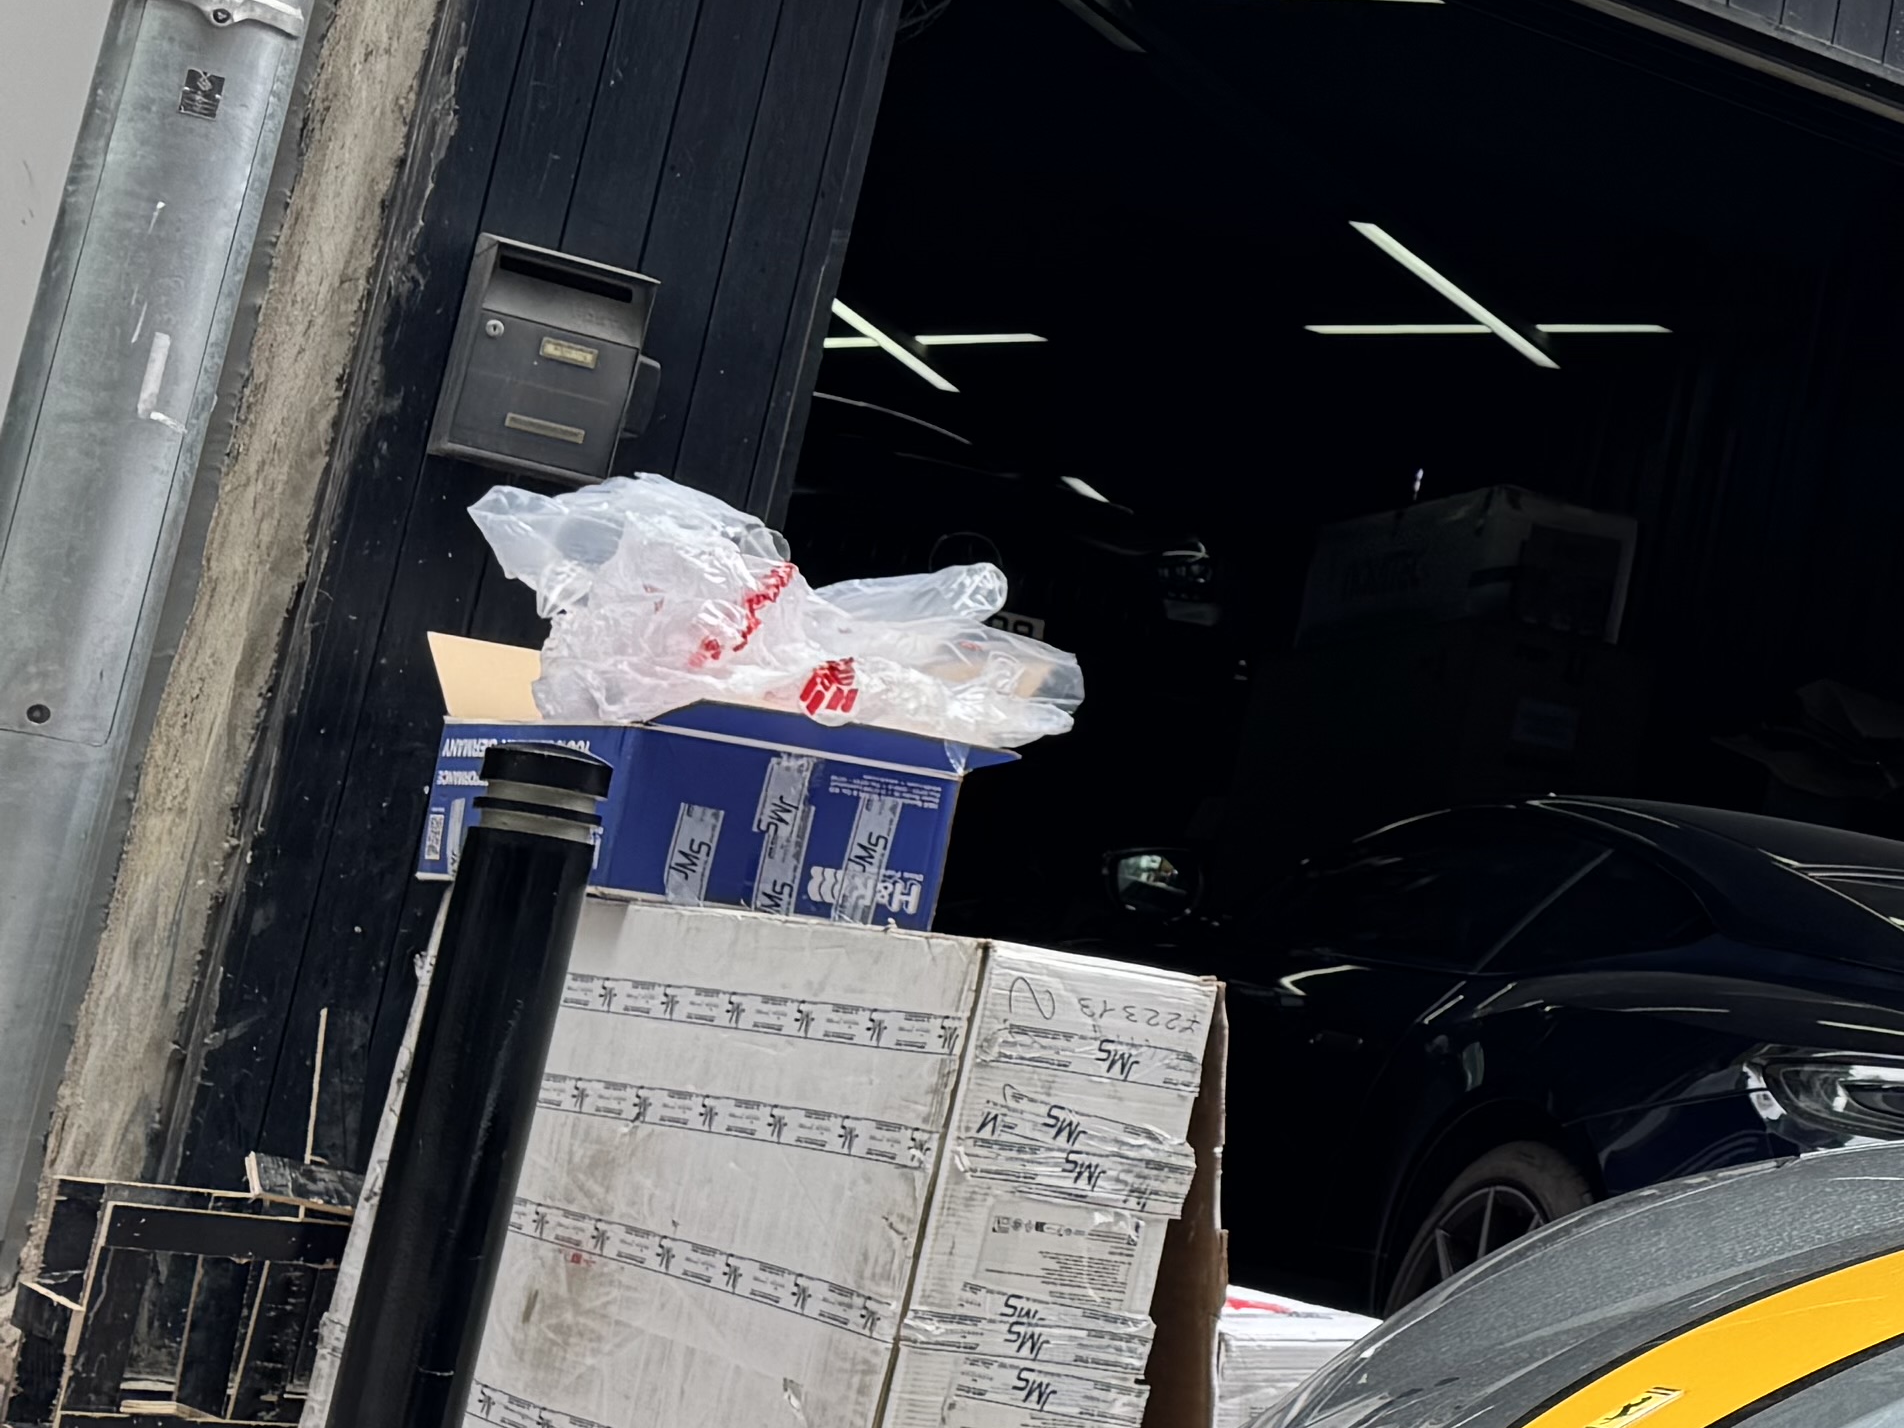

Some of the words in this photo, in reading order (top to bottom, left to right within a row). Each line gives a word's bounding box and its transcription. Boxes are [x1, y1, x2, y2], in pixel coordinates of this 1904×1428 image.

[668, 837, 712, 882] JMS
[848, 830, 888, 874] JMS
[1095, 1038, 1140, 1082] JMS
[1040, 1104, 1088, 1147] JMS
[1062, 1149, 1106, 1193] JMS
[1003, 1321, 1051, 1362] JMS
[1012, 1367, 1058, 1412] JMS
